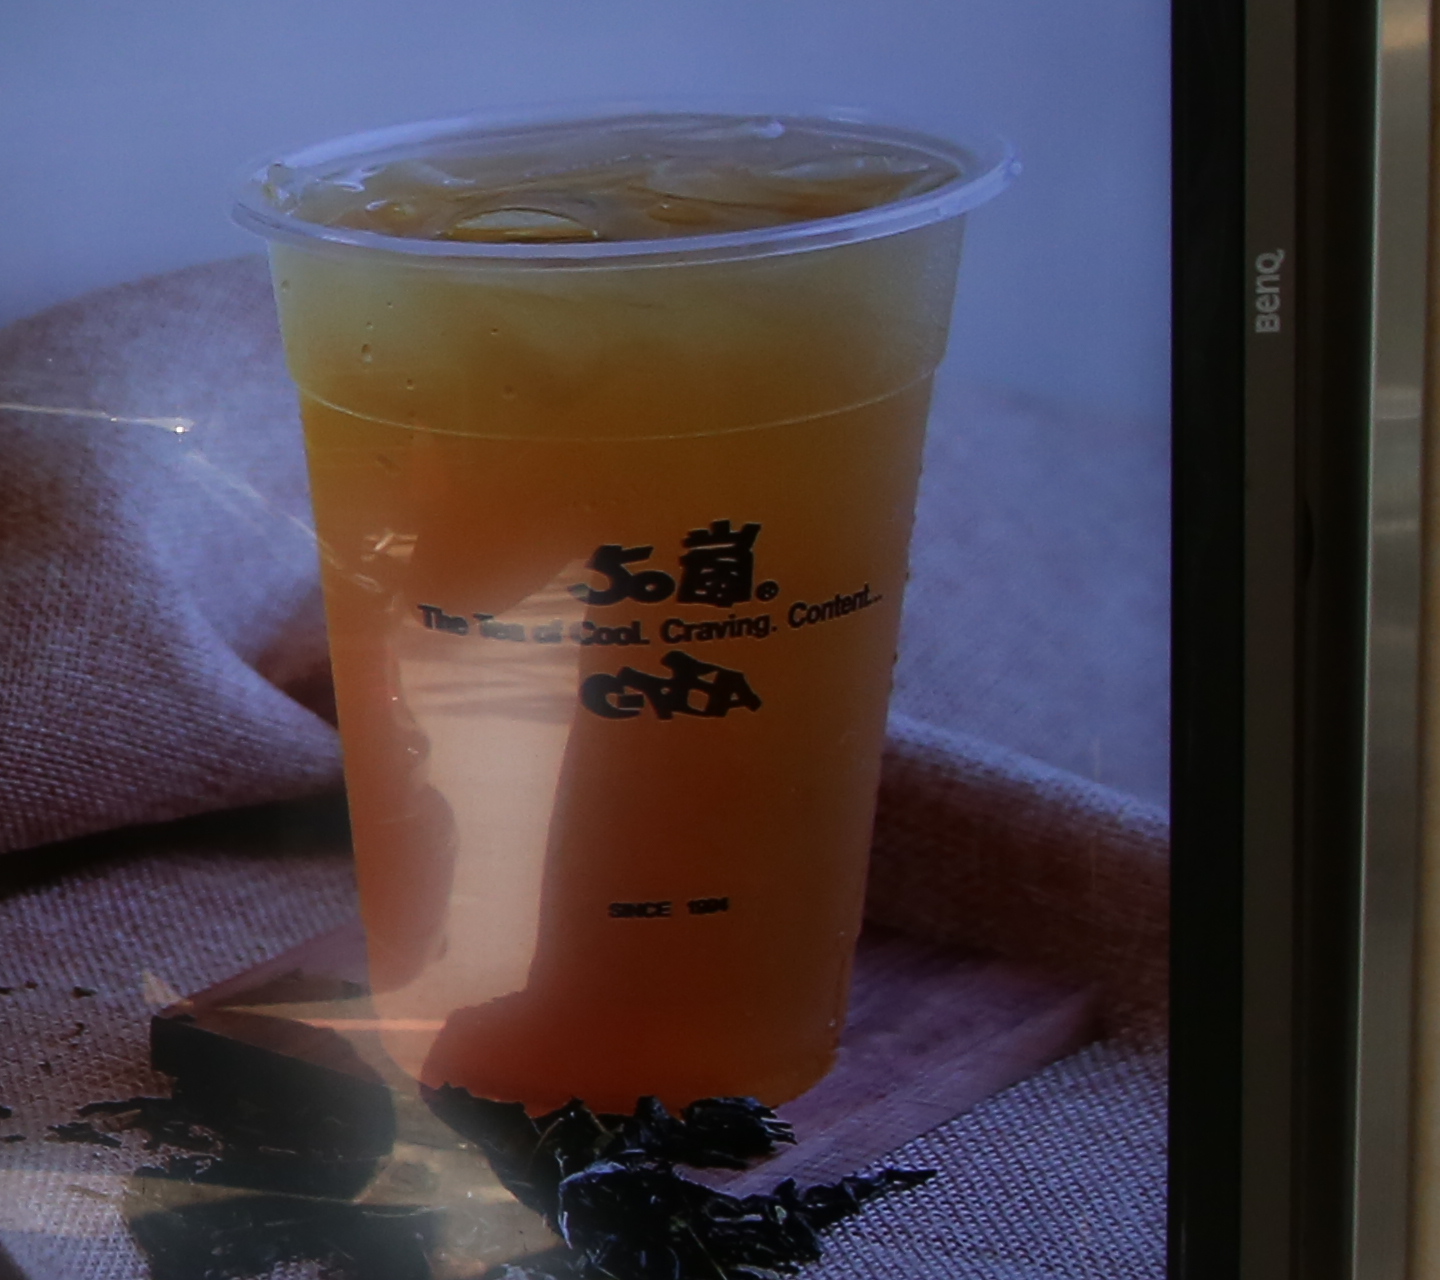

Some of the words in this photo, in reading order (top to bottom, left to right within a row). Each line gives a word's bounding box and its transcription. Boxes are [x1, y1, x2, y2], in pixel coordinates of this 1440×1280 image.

[1255, 249, 1285, 332] BenQ
[419, 603, 470, 635] The
[661, 613, 778, 644] Craving.
[608, 900, 671, 918] SINCE
